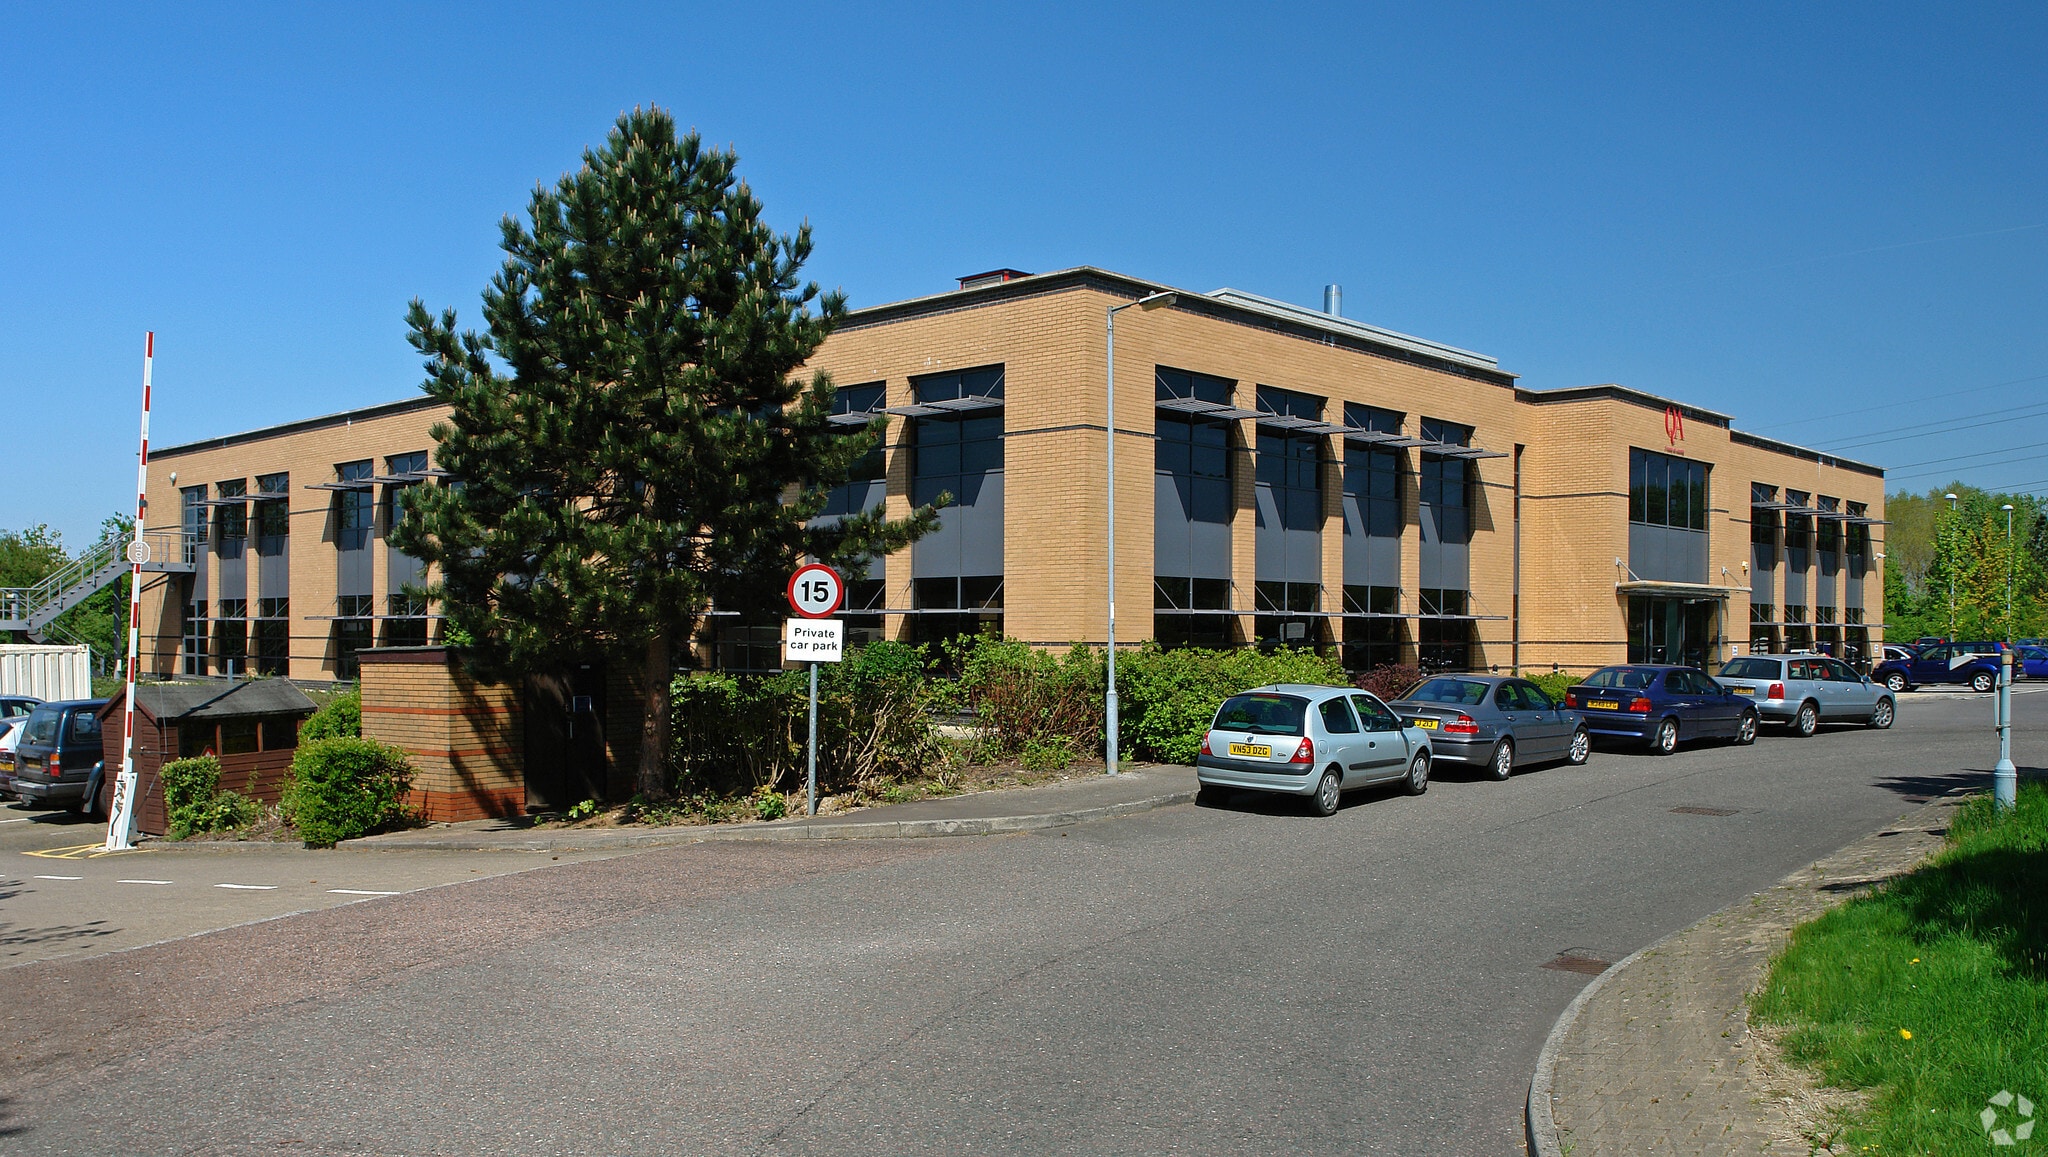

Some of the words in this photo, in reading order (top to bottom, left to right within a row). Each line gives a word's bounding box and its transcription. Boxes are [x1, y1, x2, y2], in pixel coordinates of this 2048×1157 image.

[135, 543, 143, 562] STOP
[801, 581, 829, 602] 15
[794, 627, 835, 639] Private
[790, 641, 809, 649] car
[812, 641, 838, 652] park
[1232, 744, 1251, 755] VN53
[1252, 746, 1268, 756] DZG
